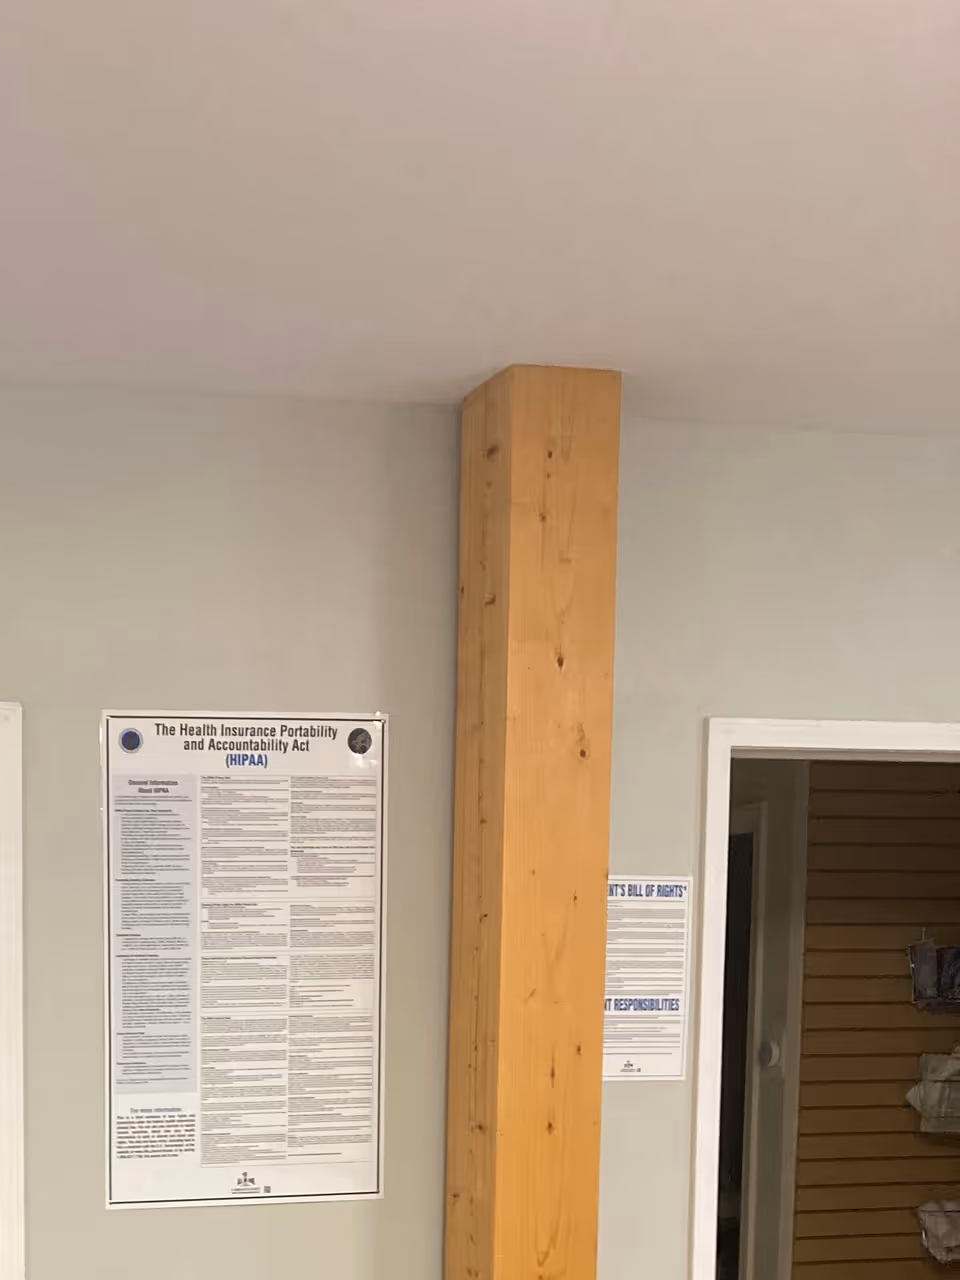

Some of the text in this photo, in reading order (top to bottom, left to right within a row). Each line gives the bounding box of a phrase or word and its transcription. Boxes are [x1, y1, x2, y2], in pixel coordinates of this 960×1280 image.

[154, 723, 338, 741] The Health Insurance Portability
[183, 739, 310, 754] and Accountability Act
[225, 753, 268, 769] (HIPAA)
[627, 883, 644, 898] BILL
[644, 884, 656, 898] OF
[613, 998, 680, 1012] RESPONSIBILITIES
